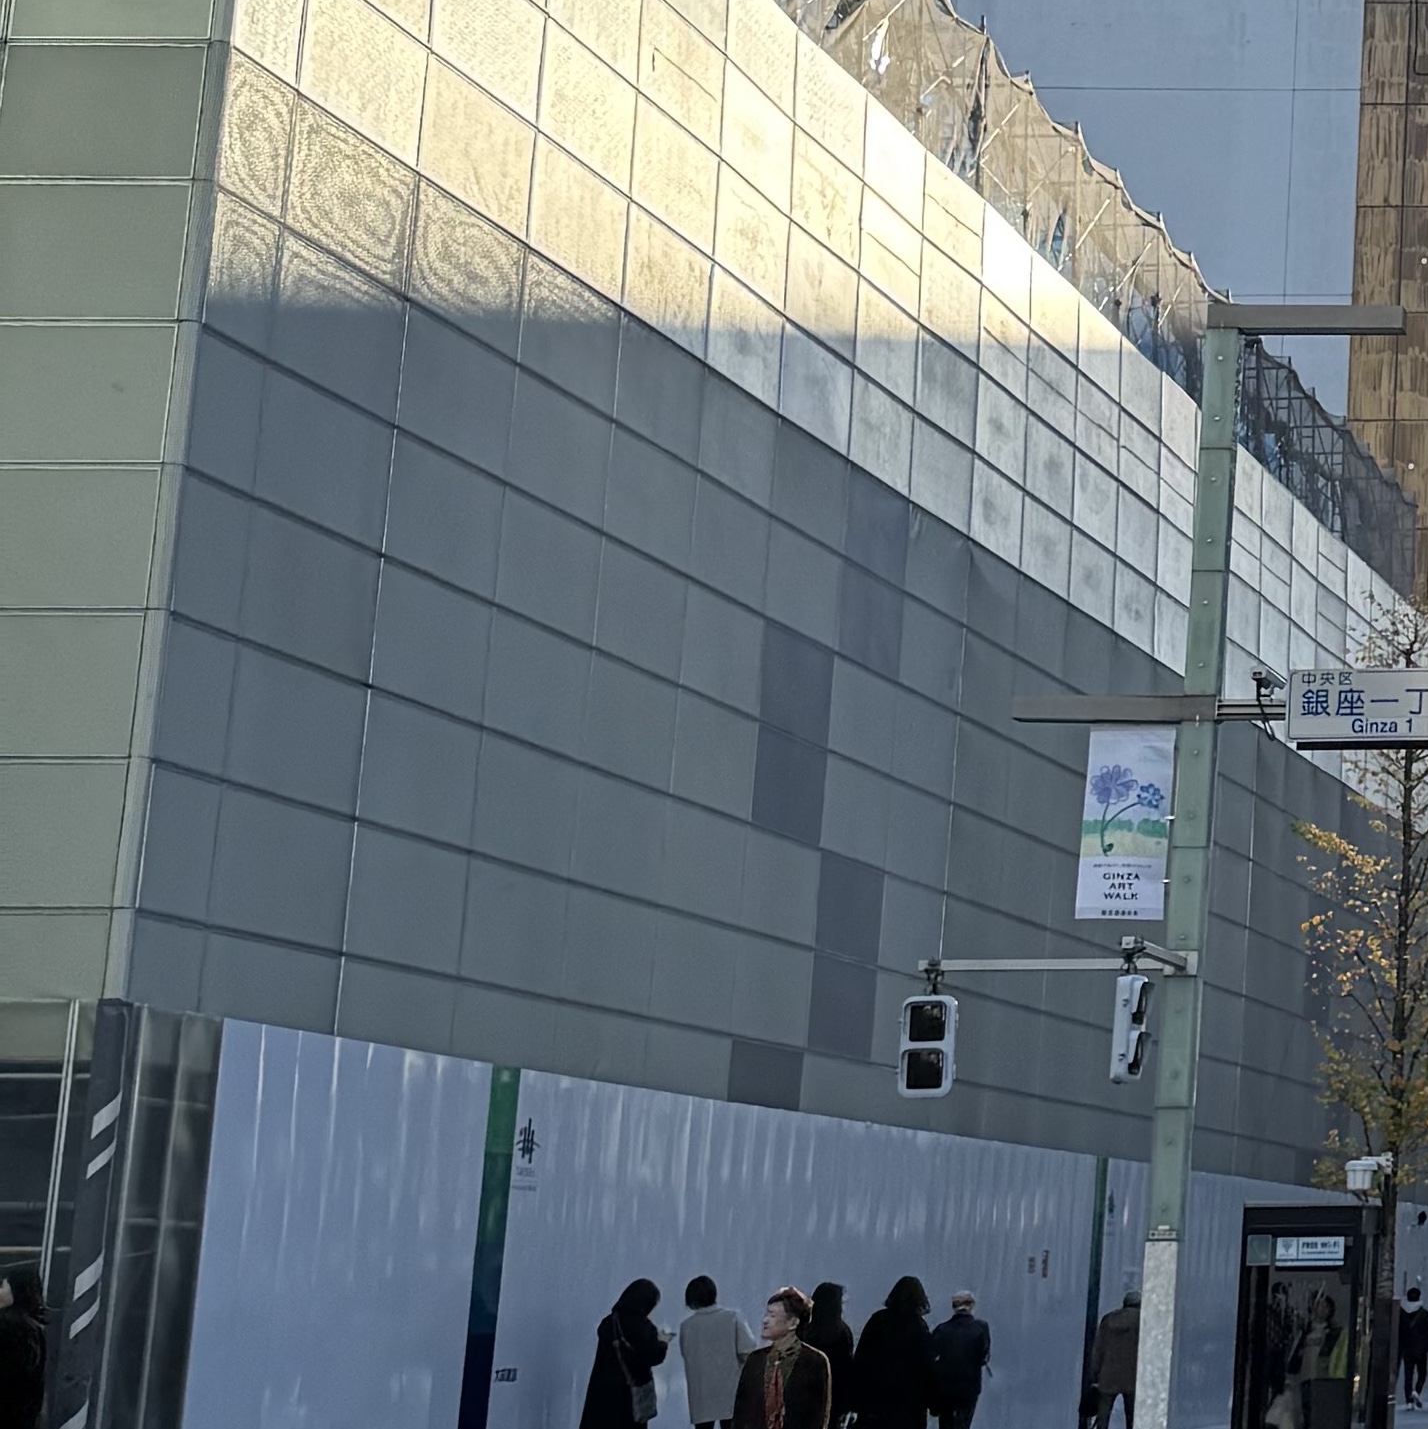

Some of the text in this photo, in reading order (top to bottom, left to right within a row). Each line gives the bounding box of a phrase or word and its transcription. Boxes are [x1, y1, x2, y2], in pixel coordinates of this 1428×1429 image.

[1302, 672, 1353, 687] 中央区
[1351, 718, 1414, 734] Ginza 1
[1103, 872, 1141, 881] GINZA
[1108, 882, 1135, 890] ART
[1103, 892, 1139, 900] WALK
